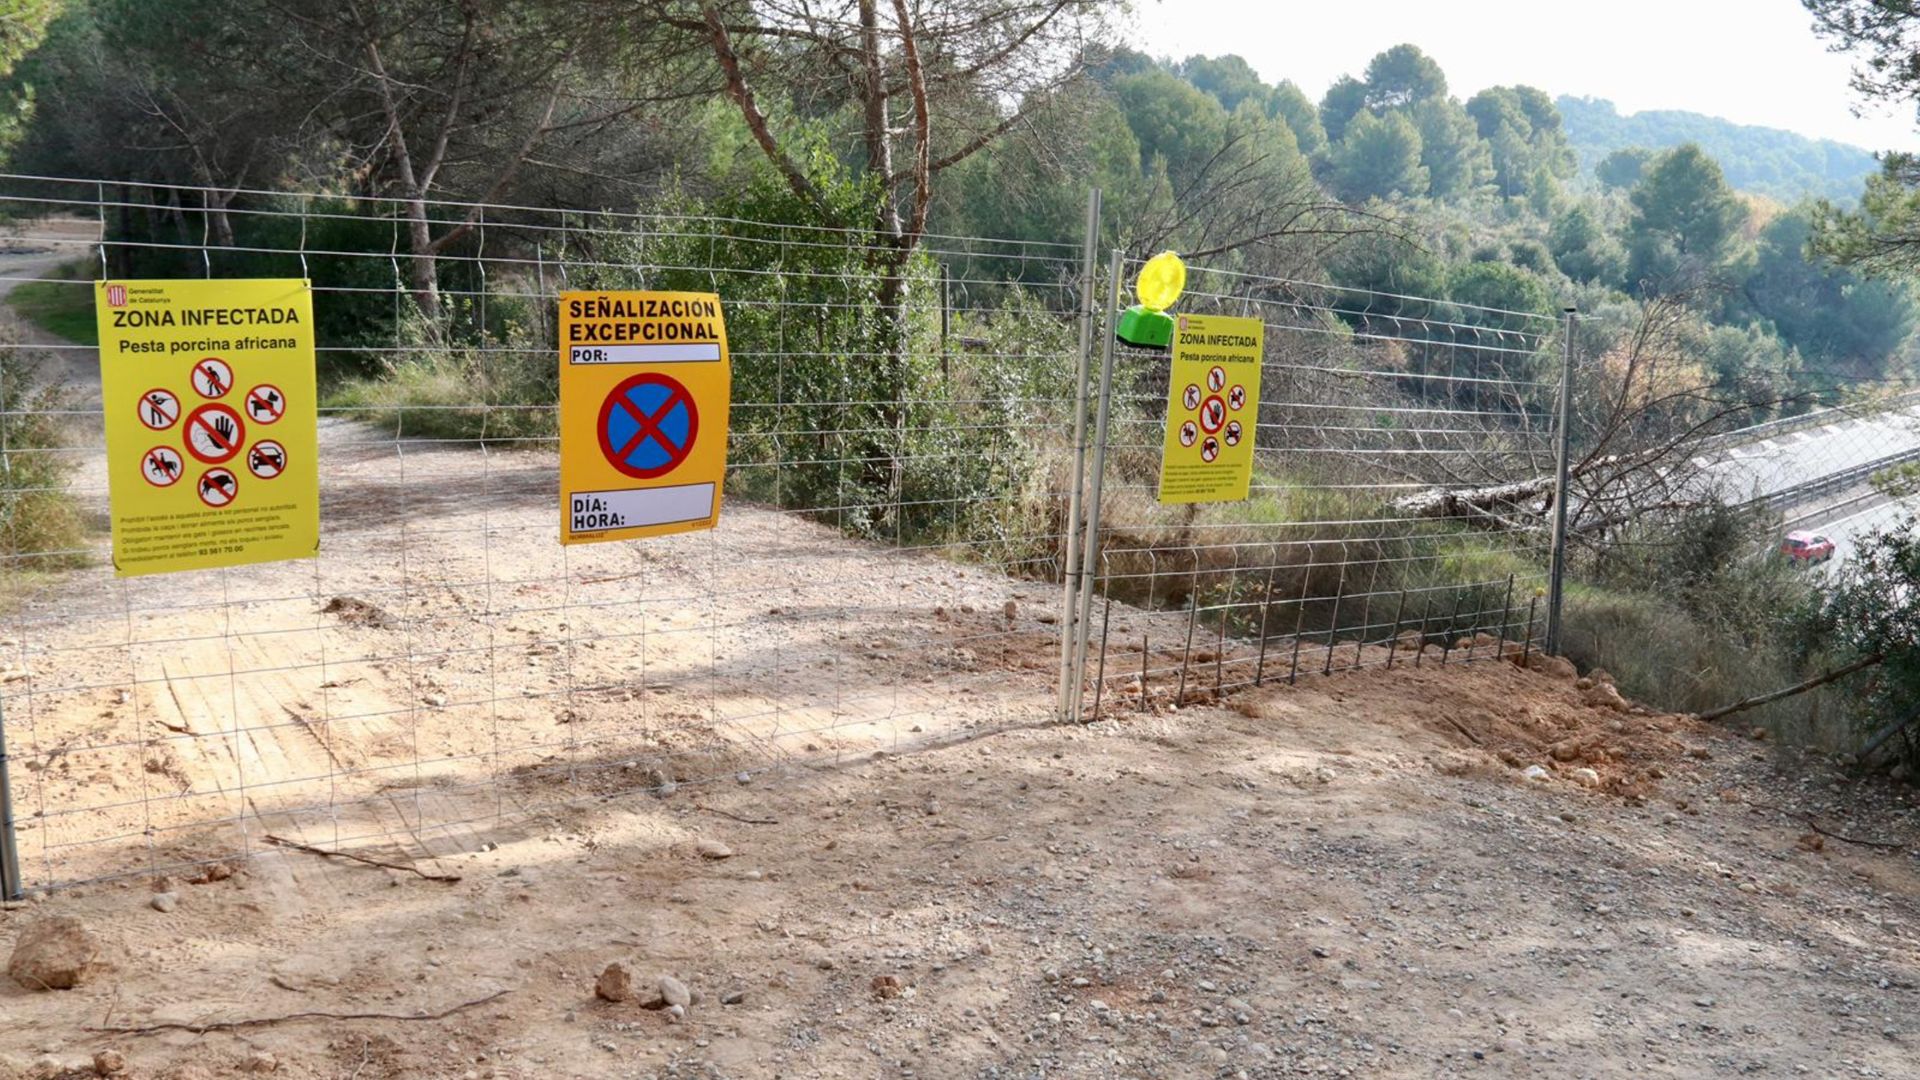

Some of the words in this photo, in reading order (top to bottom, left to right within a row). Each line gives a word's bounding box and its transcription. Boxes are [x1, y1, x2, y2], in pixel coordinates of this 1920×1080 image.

[570, 296, 715, 318] SEÑALIZACIÓN
[113, 310, 176, 327] ZONA
[182, 308, 299, 326] INFECTADA
[570, 322, 718, 341] EXCEPCIONAL
[1180, 334, 1206, 344] ZONA
[1207, 335, 1257, 347] INFECTADA
[119, 339, 165, 353] Pesta
[170, 338, 231, 355] porcina
[235, 336, 296, 351] africana
[572, 350, 608, 362] POR:
[1180, 352, 1200, 361] Pesta
[1201, 353, 1226, 362] porcina
[1228, 354, 1254, 363] africana
[574, 495, 607, 513] DÍA:
[574, 513, 625, 529] HORA:
